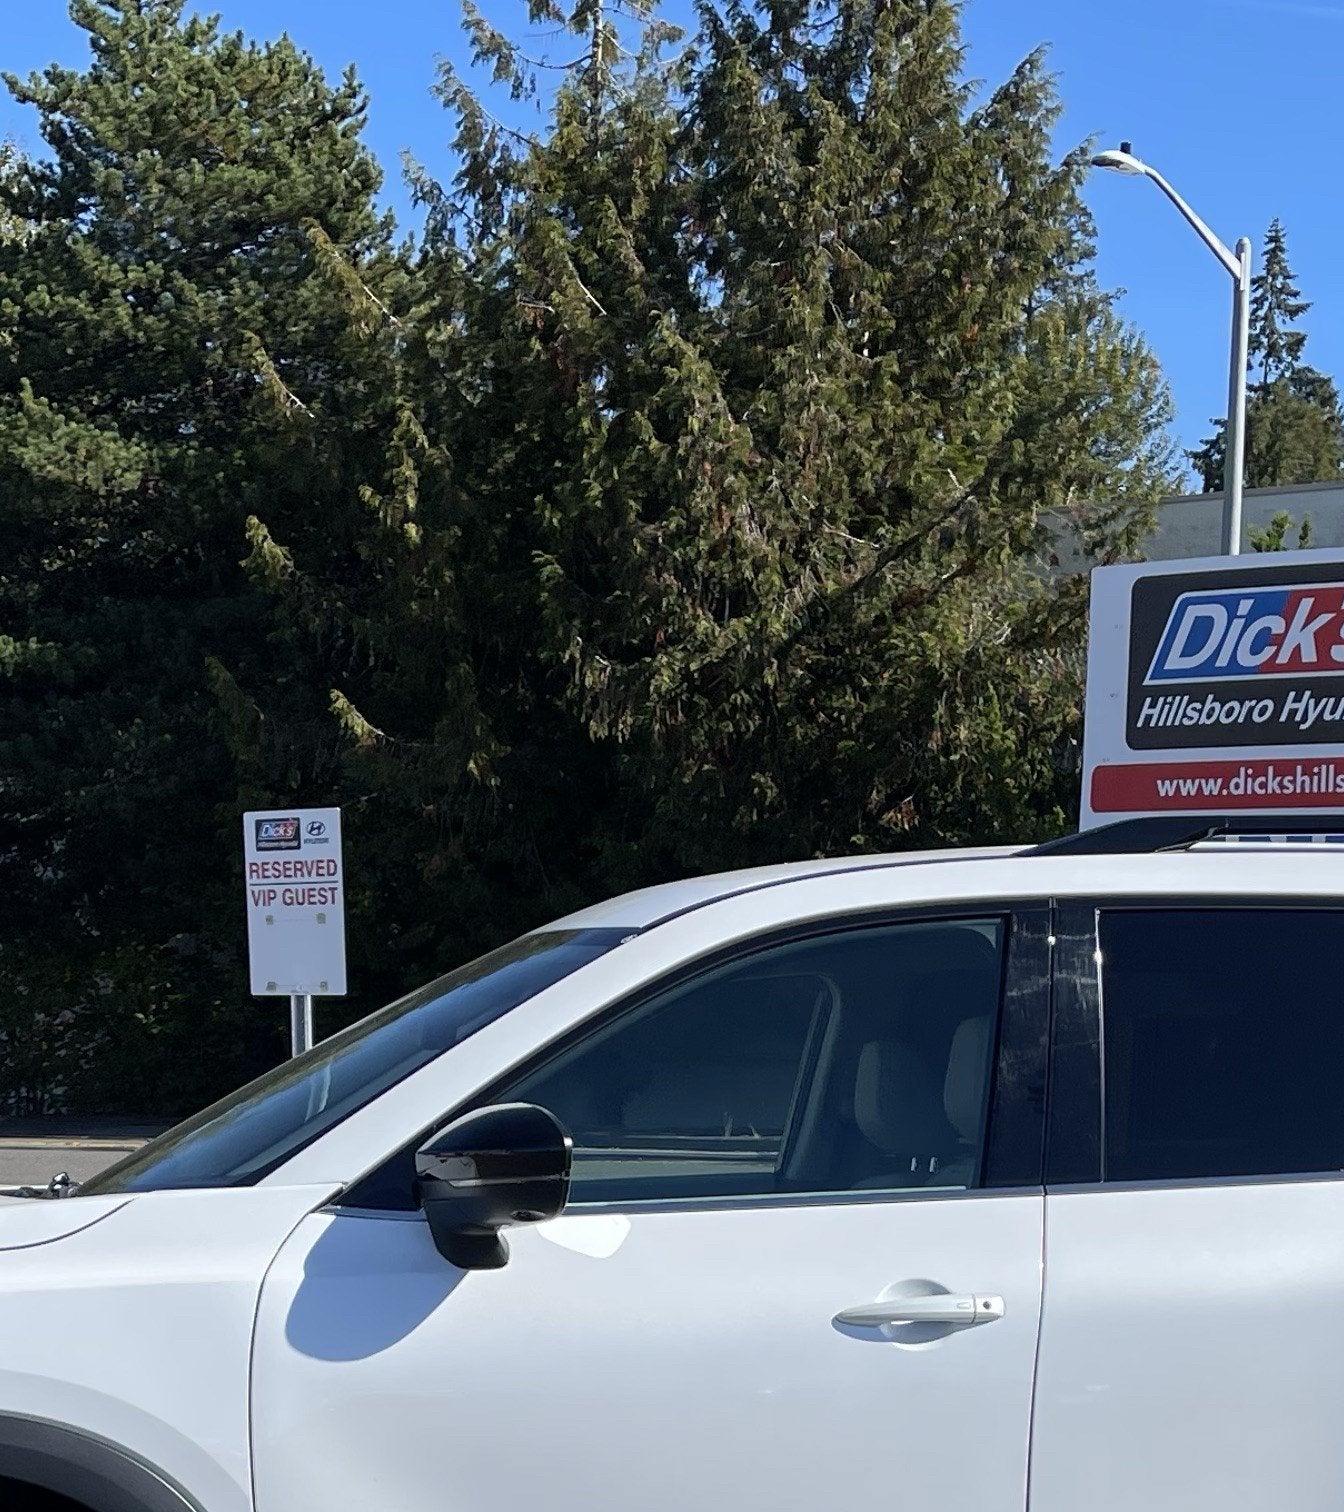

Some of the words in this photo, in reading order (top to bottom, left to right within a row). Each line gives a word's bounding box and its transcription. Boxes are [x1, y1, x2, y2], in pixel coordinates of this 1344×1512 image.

[1136, 694, 1274, 728] Hillsboro
[249, 859, 338, 879] RESERVED
[251, 889, 277, 907] VIP
[282, 887, 338, 906] GUEST
